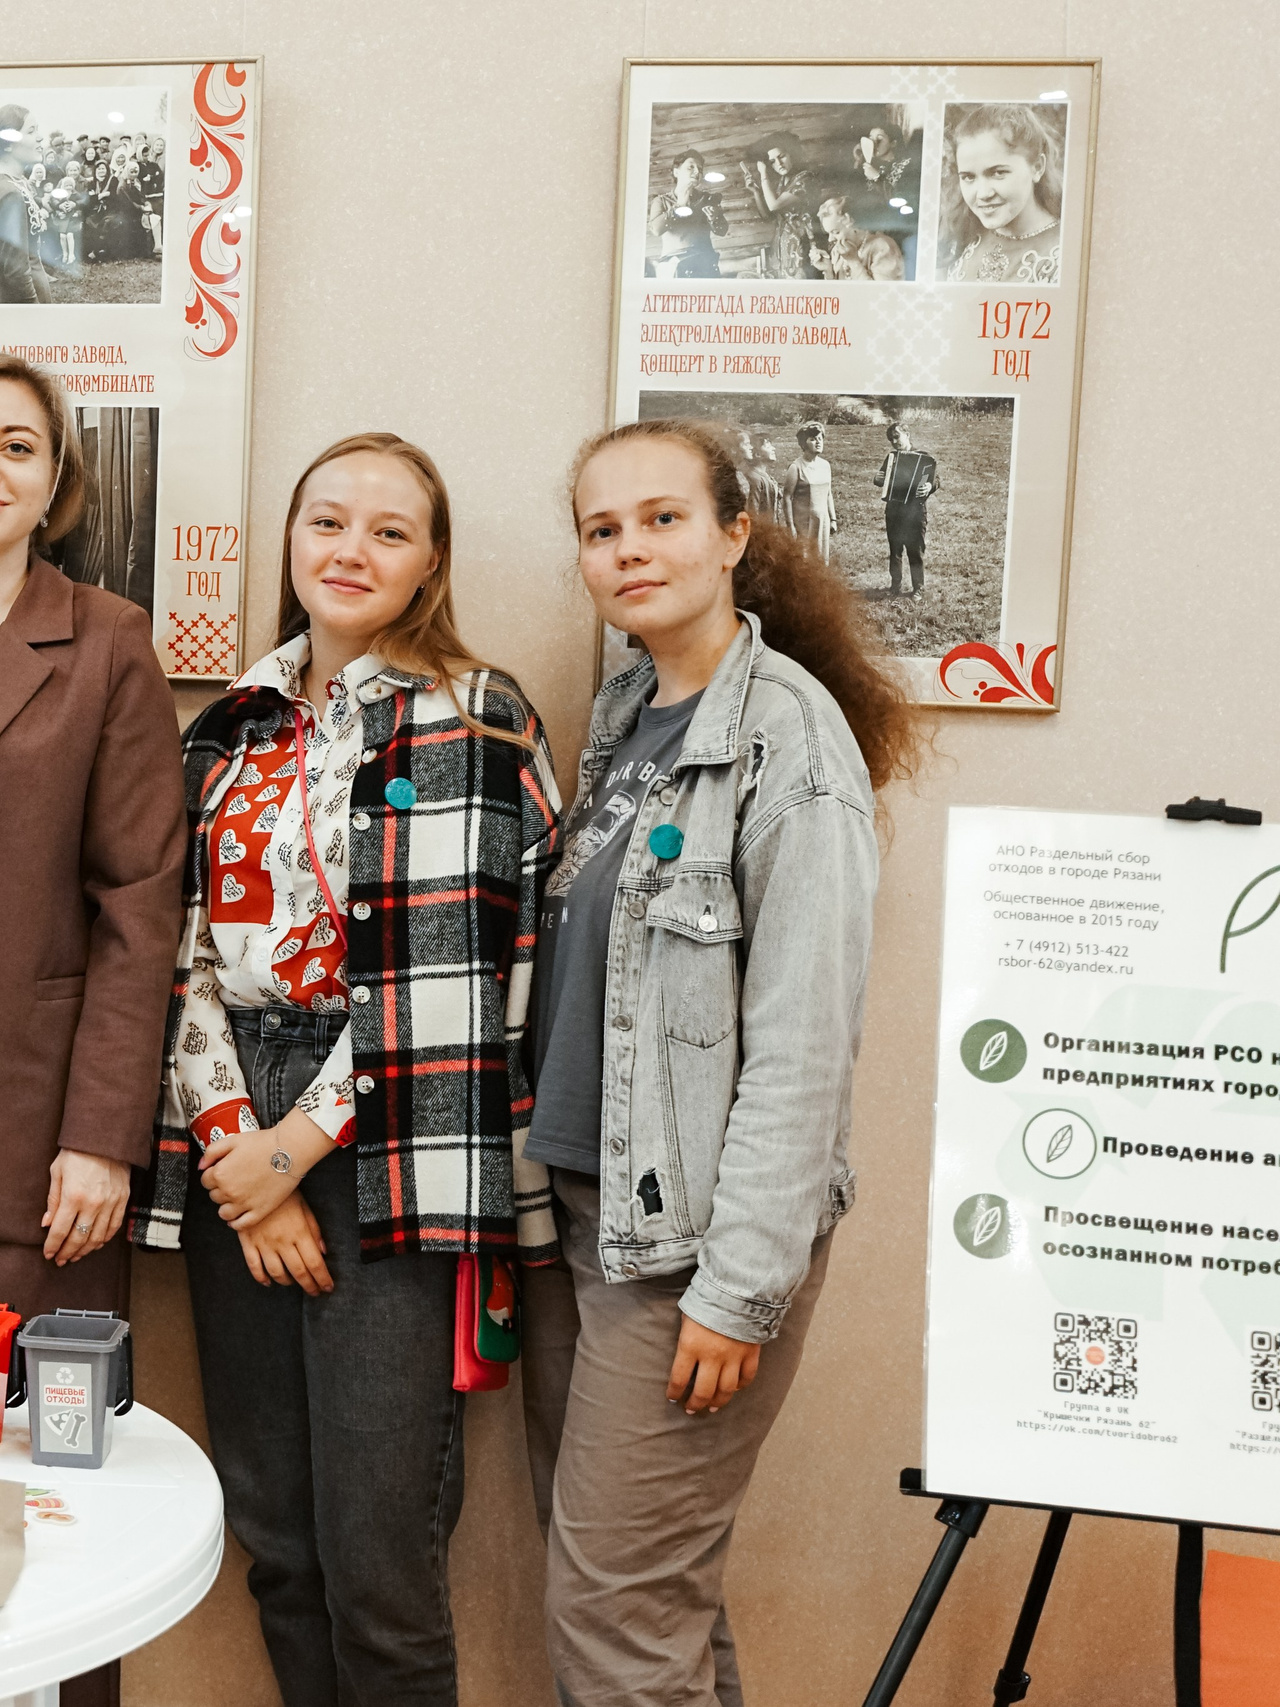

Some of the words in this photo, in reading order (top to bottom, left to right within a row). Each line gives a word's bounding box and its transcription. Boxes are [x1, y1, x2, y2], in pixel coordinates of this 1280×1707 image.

[642, 293, 745, 317] АГИТБРИГАДА
[749, 295, 840, 318] РЯЗАНСКОГО
[978, 298, 1052, 341] 1972
[640, 323, 788, 346] ЭЛЕКТРОЛАМПОВОГО
[791, 325, 852, 349] ЗАВОДА,
[72, 345, 128, 366] ЗАВОДА,
[640, 353, 705, 376] КОНЦЕРТ
[708, 355, 718, 373] В
[722, 355, 782, 378] РЯЖСКЕ
[991, 348, 1031, 383] ГОД
[171, 524, 239, 563] 1972
[185, 570, 222, 603] ГОД
[996, 845, 1026, 857] АНО
[1030, 846, 1113, 862] Раздельный
[1117, 851, 1151, 867] сбор
[988, 863, 1043, 876] отходов
[1048, 866, 1056, 875] в
[1060, 867, 1109, 880] городе
[1113, 867, 1162, 882] Рязани
[983, 890, 1085, 908] Общественное
[1089, 899, 1165, 914] движение,
[993, 910, 1075, 924] основанное
[1079, 915, 1087, 925] в
[1091, 913, 1123, 927] 2015
[1127, 918, 1159, 932] году
[1016, 938, 1024, 951] 7
[1029, 940, 1071, 956] (4912)
[1076, 942, 1129, 958] 513-422
[998, 955, 1134, 975] rsbor-62@yandex.ru
[1043, 1032, 1205, 1061] Организация
[1213, 1044, 1263, 1064] РСО
[1042, 1067, 1215, 1093] предприятиях
[1223, 1080, 1280, 1101] горо
[1102, 1136, 1255, 1165] Проведение
[1262, 1153, 1280, 1168] а
[1043, 1205, 1214, 1237] Просвещение
[1221, 1224, 1280, 1243] насе
[1042, 1241, 1193, 1268] осознанном
[45, 1386, 86, 1396] ПИЩЕВЫЕ
[46, 1395, 85, 1405] ОТХОДЫ
